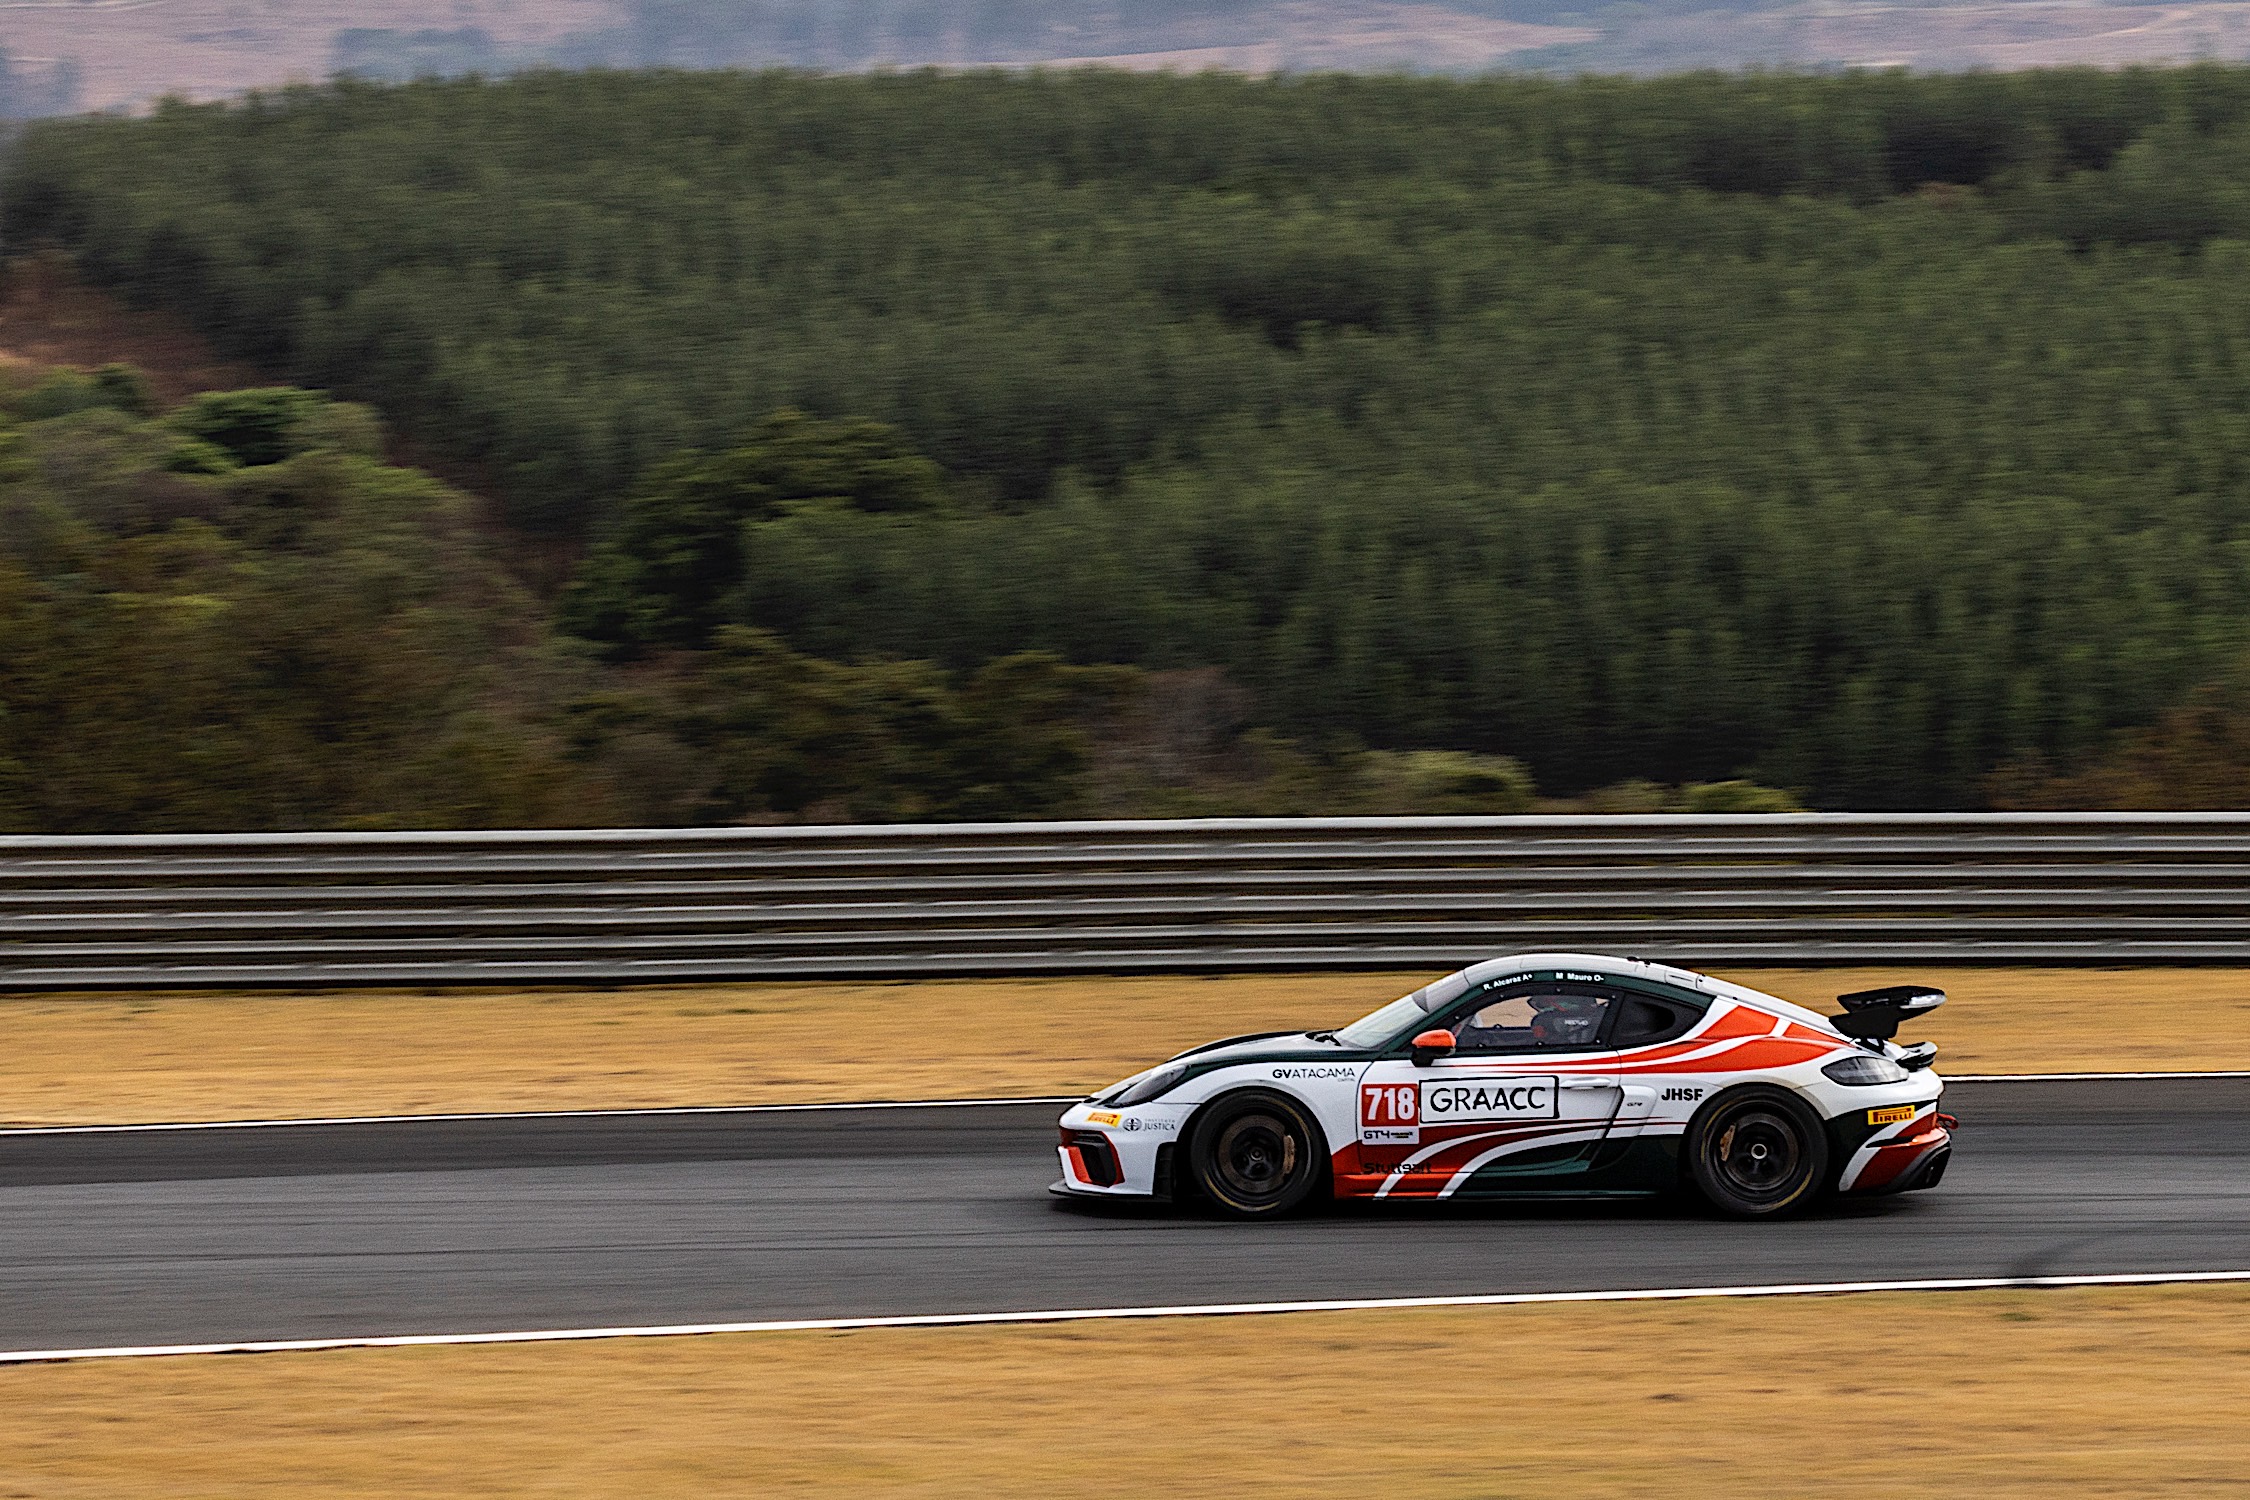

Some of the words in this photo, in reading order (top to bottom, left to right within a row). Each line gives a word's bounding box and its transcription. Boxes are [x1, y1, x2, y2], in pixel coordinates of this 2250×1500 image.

[1493, 976, 1521, 987] Alcaraz
[1567, 973, 1592, 981] Mauro
[1430, 1086, 1546, 1112] GRAACC
[1661, 1088, 1704, 1101] JHSF
[1365, 1087, 1415, 1121] 718
[1872, 1107, 1912, 1122] PIRELLI
[1363, 1130, 1390, 1139] GT4
